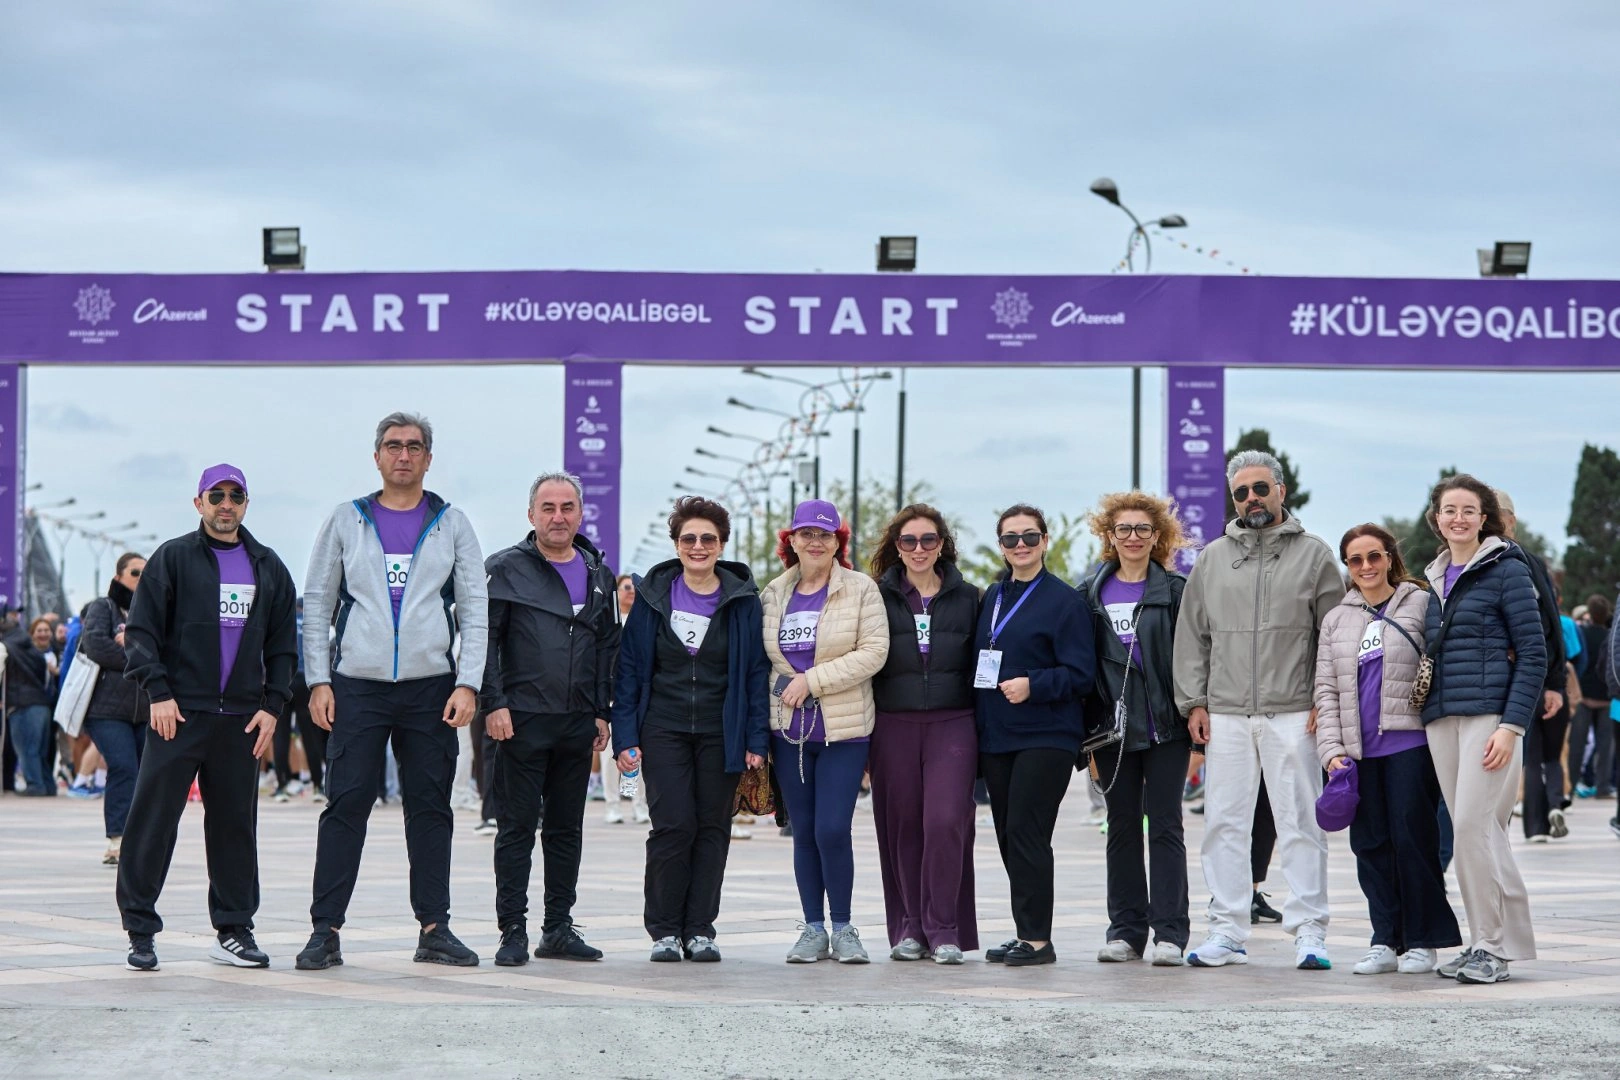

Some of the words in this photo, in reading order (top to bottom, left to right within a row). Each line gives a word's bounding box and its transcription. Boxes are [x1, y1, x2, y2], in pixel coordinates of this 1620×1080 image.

[159, 308, 207, 321] Azercell
[235, 293, 450, 334] START
[484, 297, 712, 325] #KÜLƏYƏQALİBGƏL
[744, 295, 958, 336] START
[1077, 312, 1125, 324] Azercell
[685, 630, 696, 644] 2
[1359, 635, 1381, 652] 06
